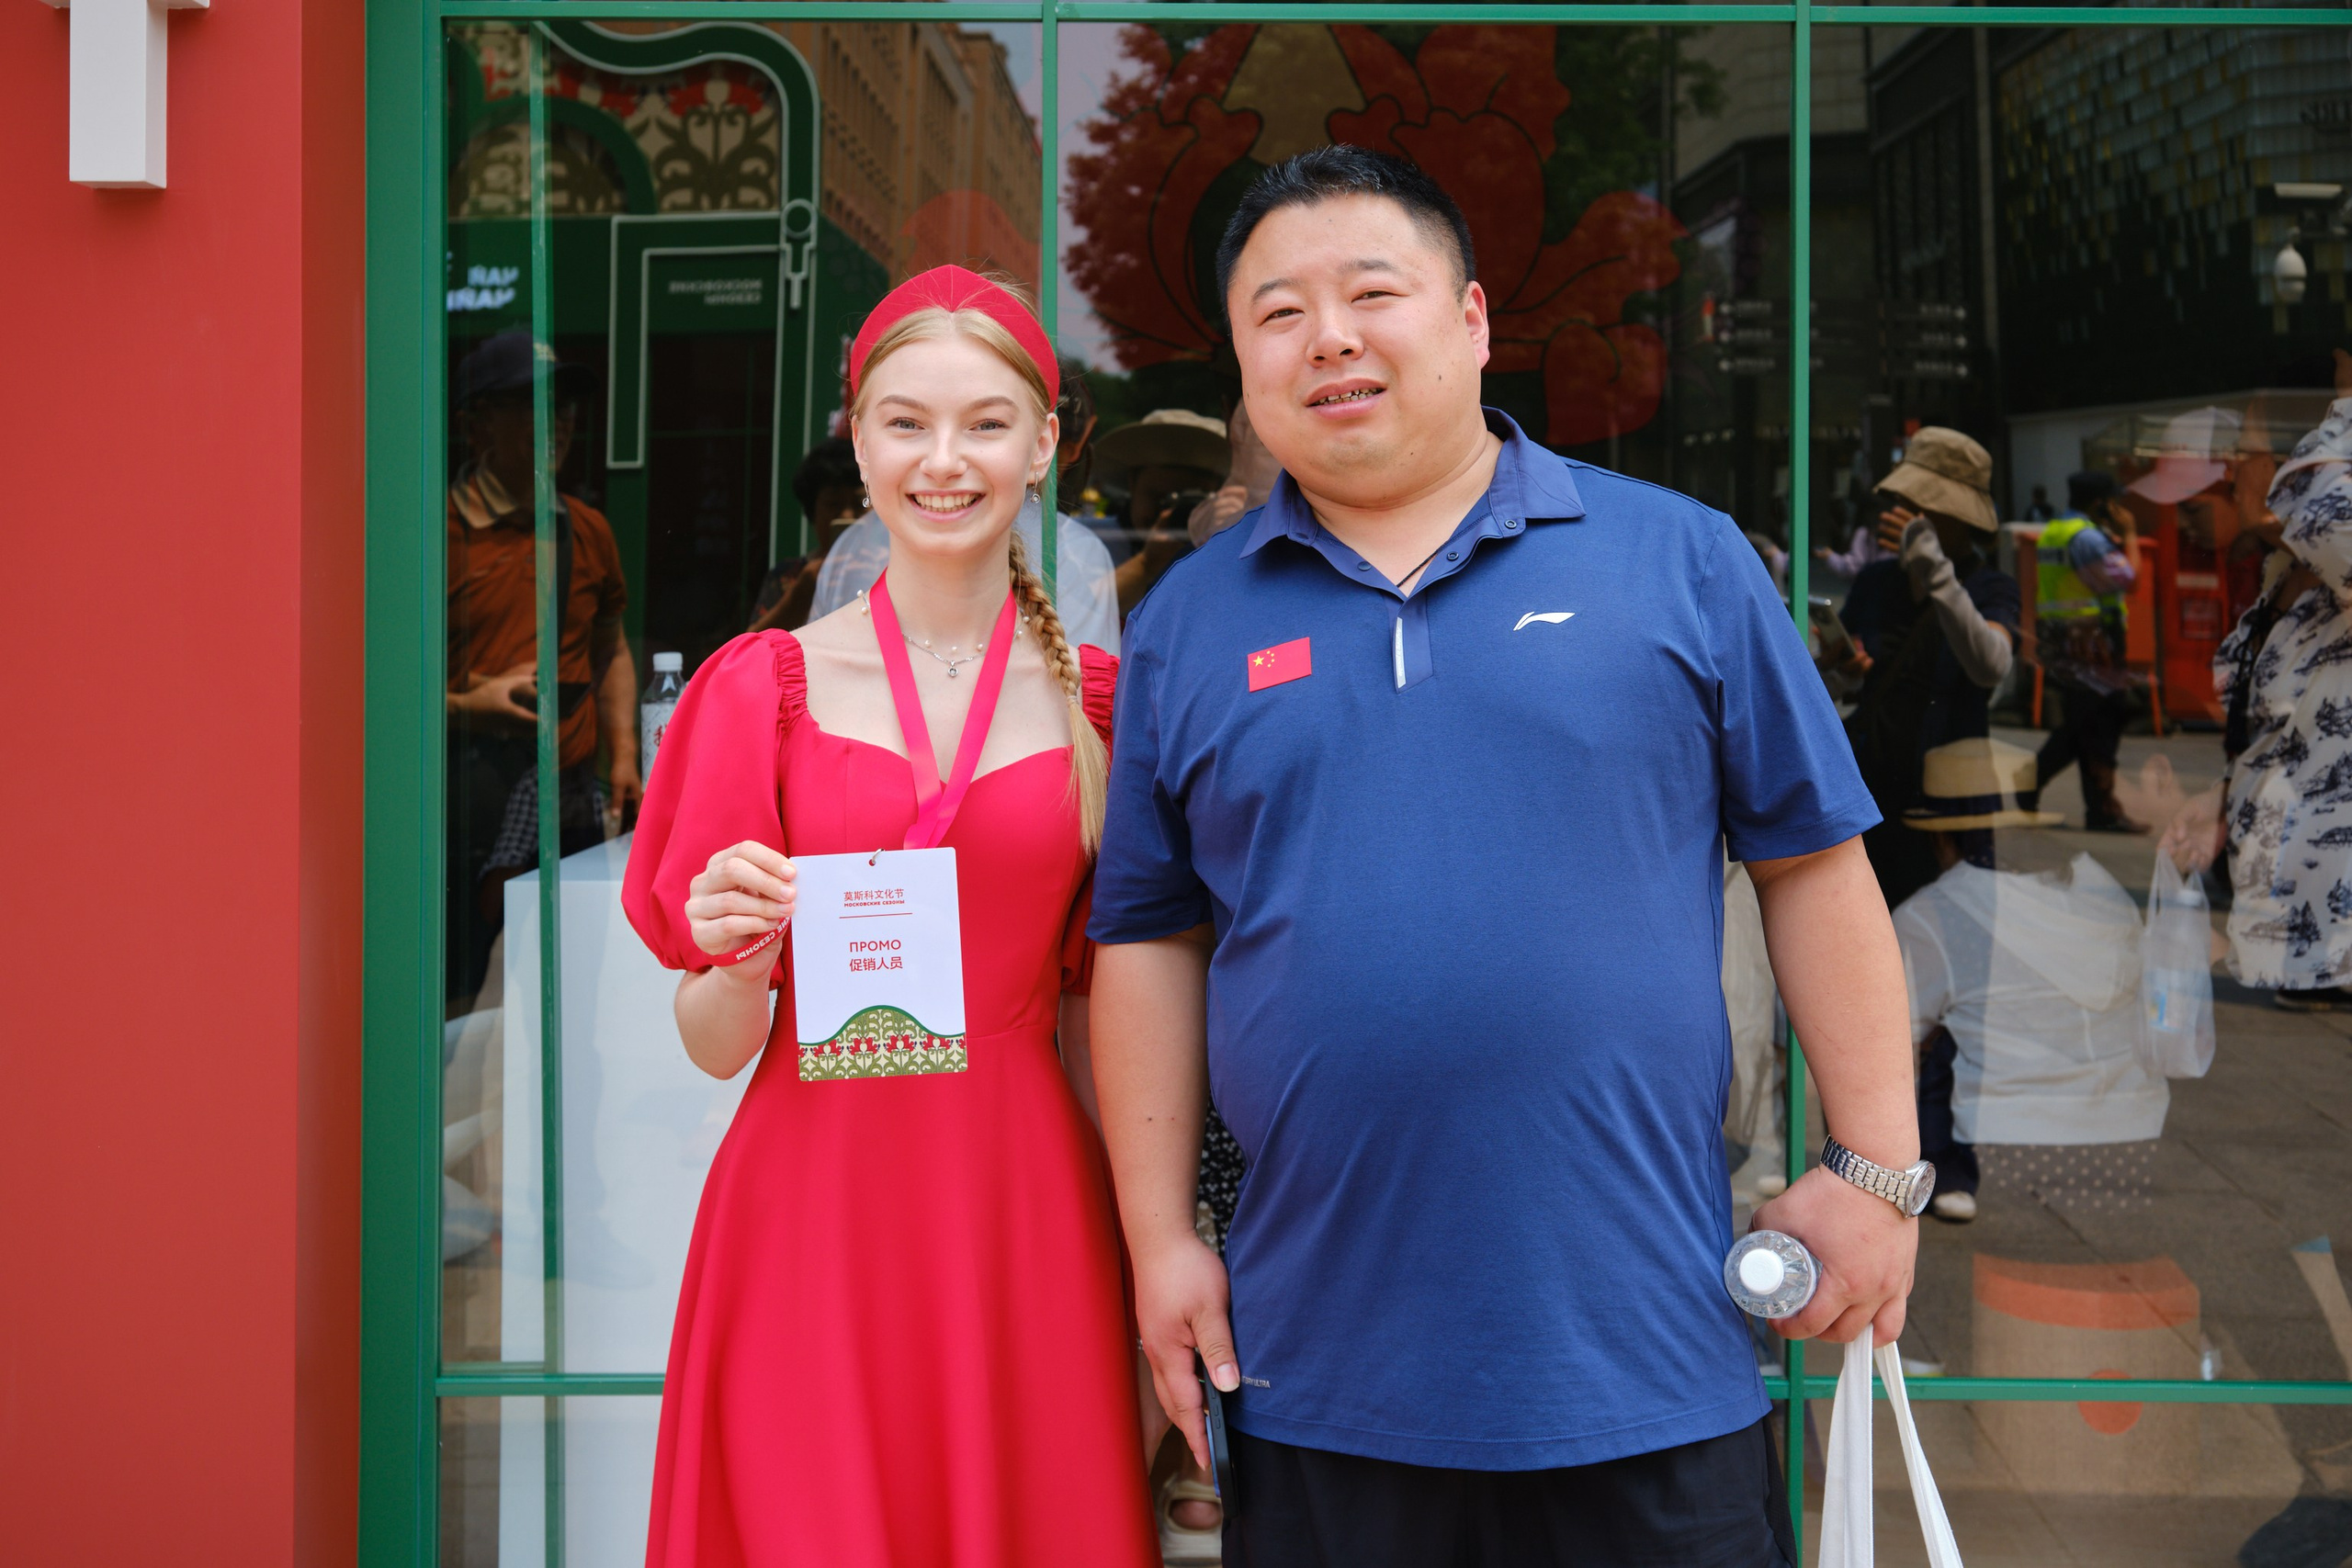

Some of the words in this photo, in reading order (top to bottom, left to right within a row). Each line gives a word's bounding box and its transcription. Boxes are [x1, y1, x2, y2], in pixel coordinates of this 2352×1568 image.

[843, 887, 904, 901] 莫斯科文化节
[736, 931, 775, 961] СЕЗОНЫ
[849, 939, 901, 953] ПРОМО
[849, 956, 903, 972] 促销人员
